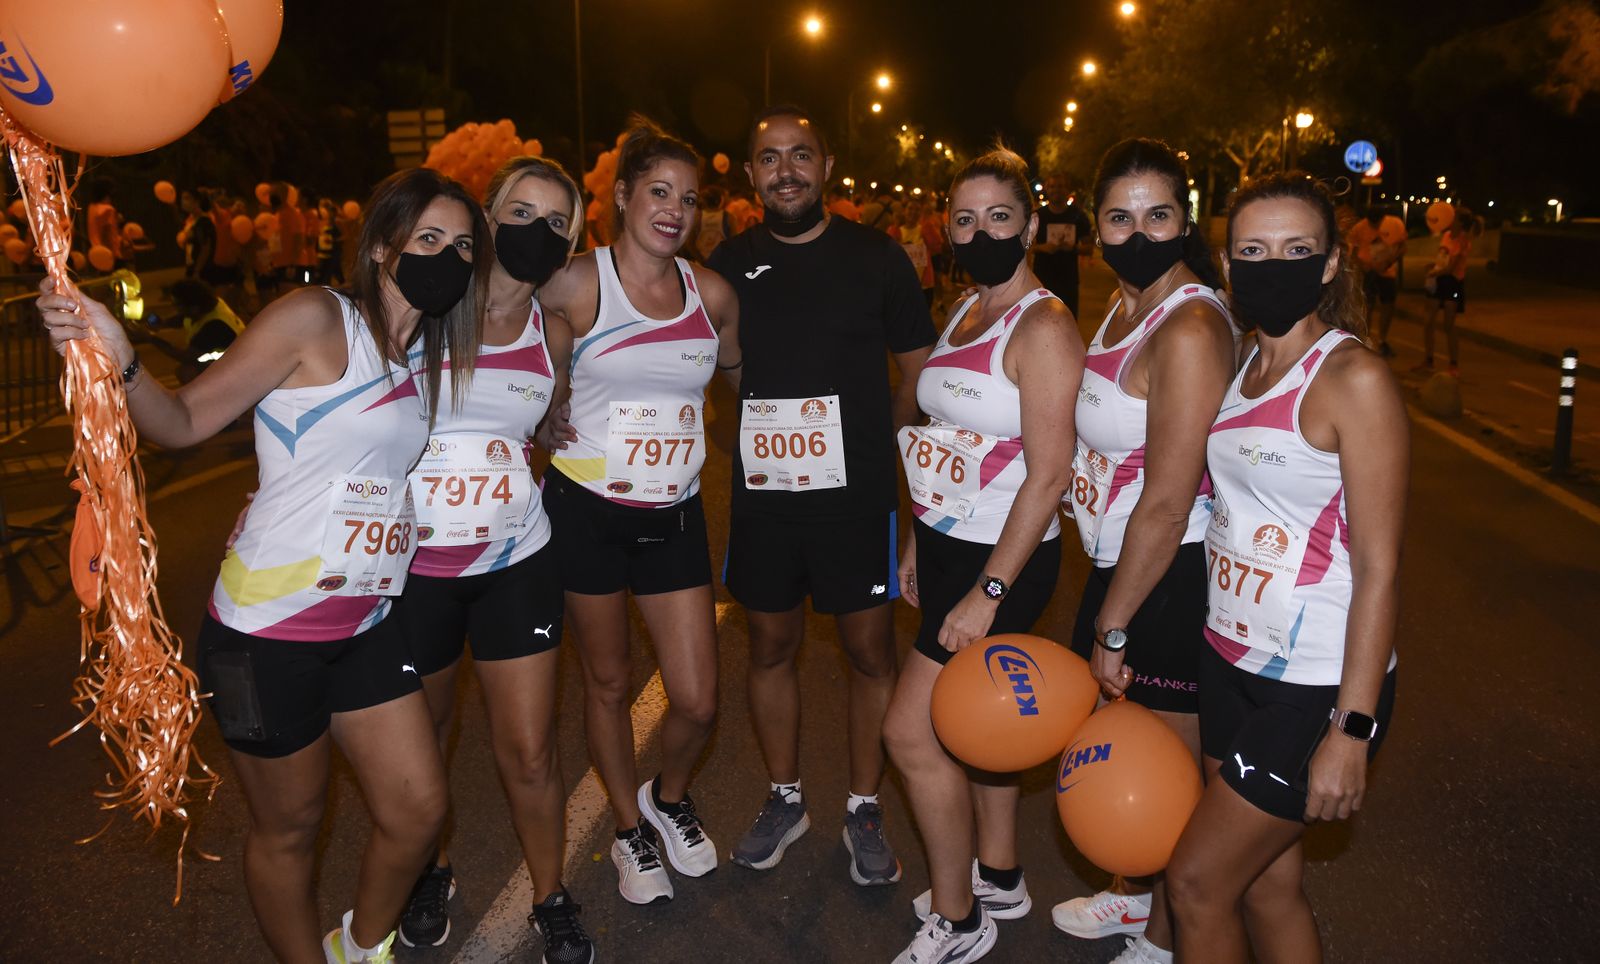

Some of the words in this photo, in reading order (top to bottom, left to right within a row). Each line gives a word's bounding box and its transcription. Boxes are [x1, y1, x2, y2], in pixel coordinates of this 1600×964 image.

[624, 439, 695, 466] 7977
[754, 431, 827, 459] 8006
[906, 431, 966, 484] 7876
[422, 475, 513, 506] 7974
[344, 520, 411, 555] 7968
[1208, 548, 1273, 605] 7877
